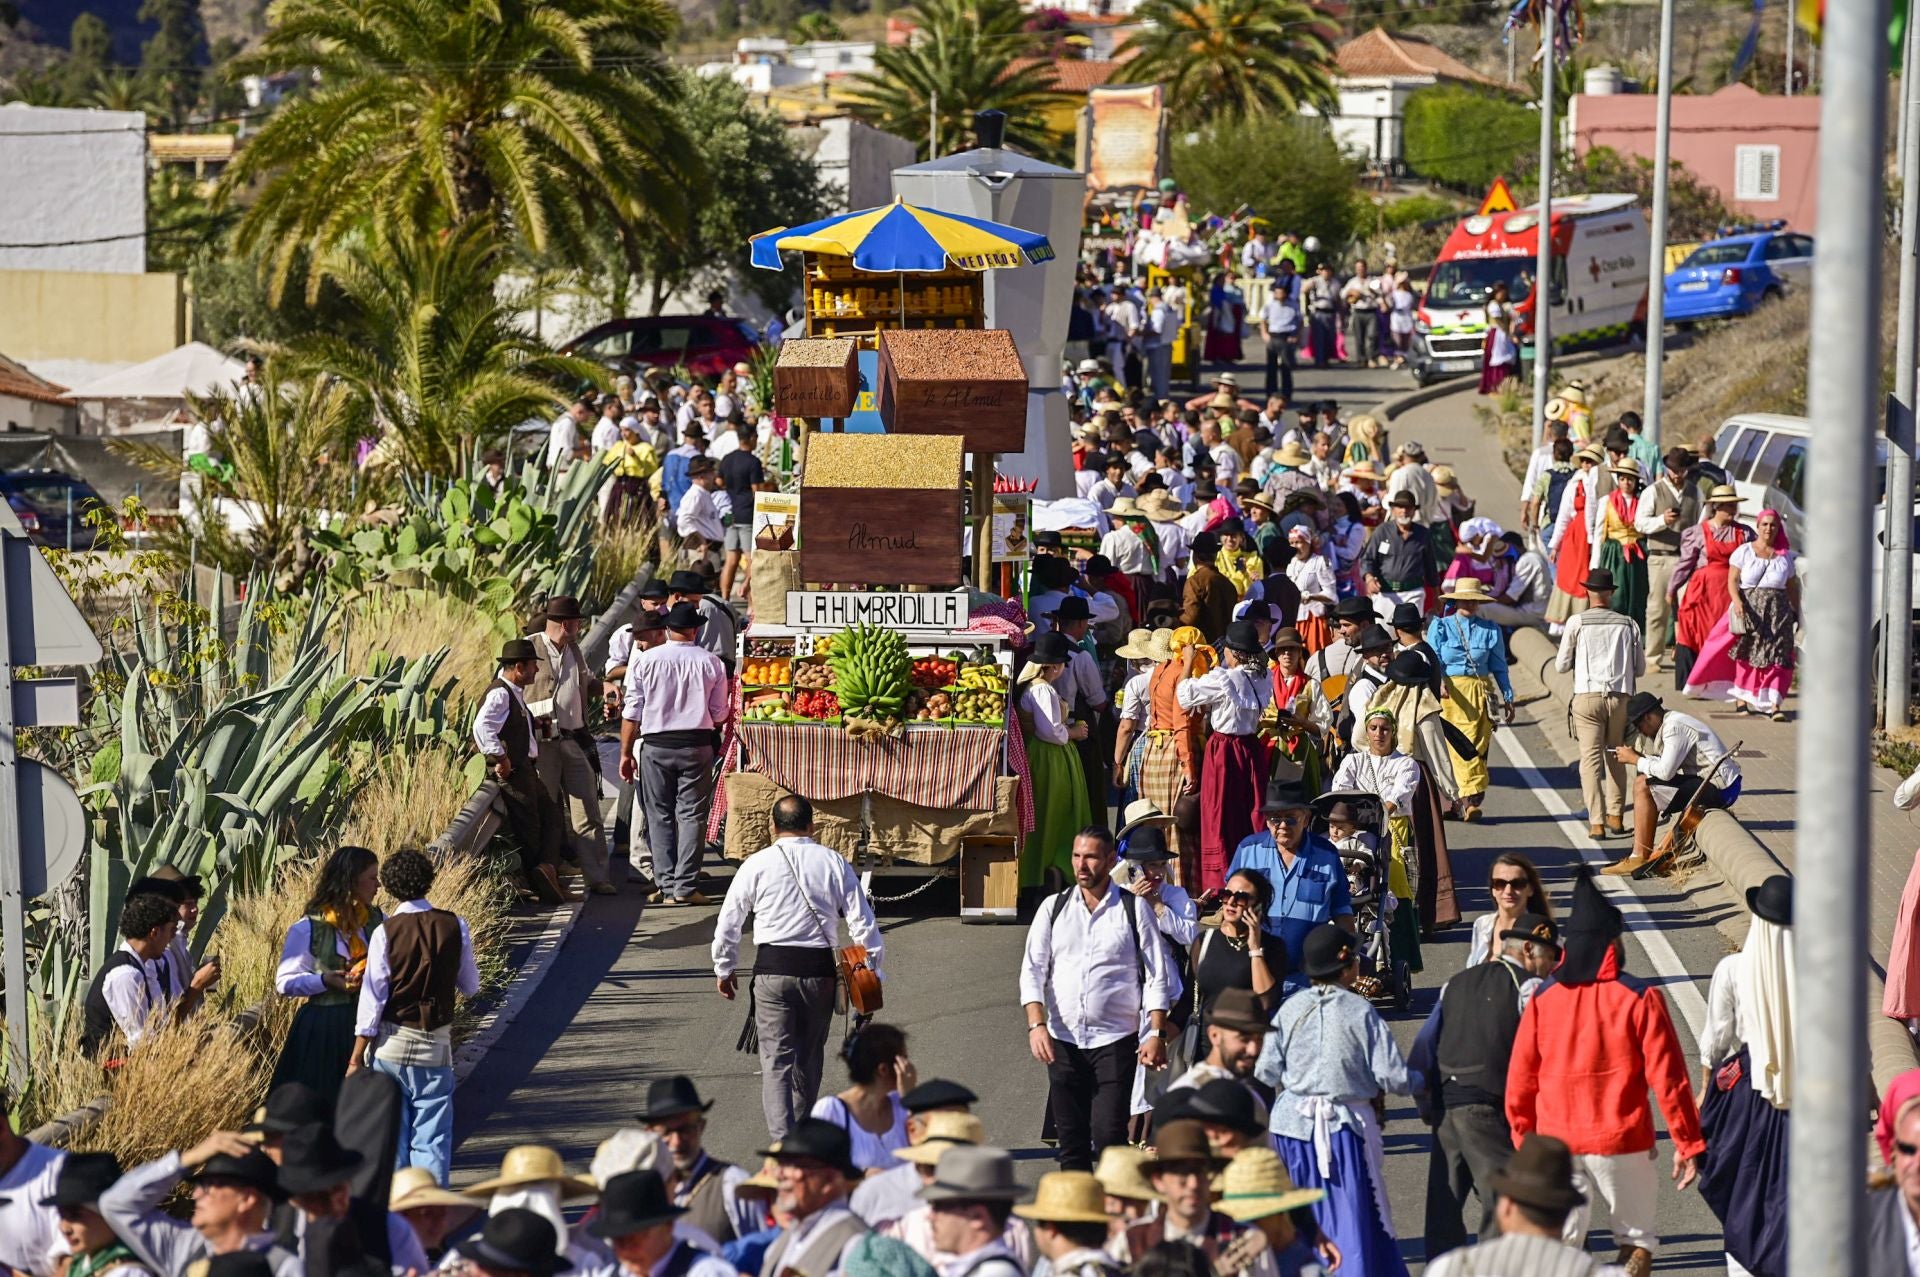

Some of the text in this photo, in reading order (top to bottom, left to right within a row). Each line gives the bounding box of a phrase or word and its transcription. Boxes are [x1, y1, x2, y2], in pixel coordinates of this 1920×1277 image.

[958, 253, 1018, 268] MEDEROS
[942, 385, 1004, 407] Almud
[848, 522, 919, 550] Almud
[800, 595, 827, 624] LA
